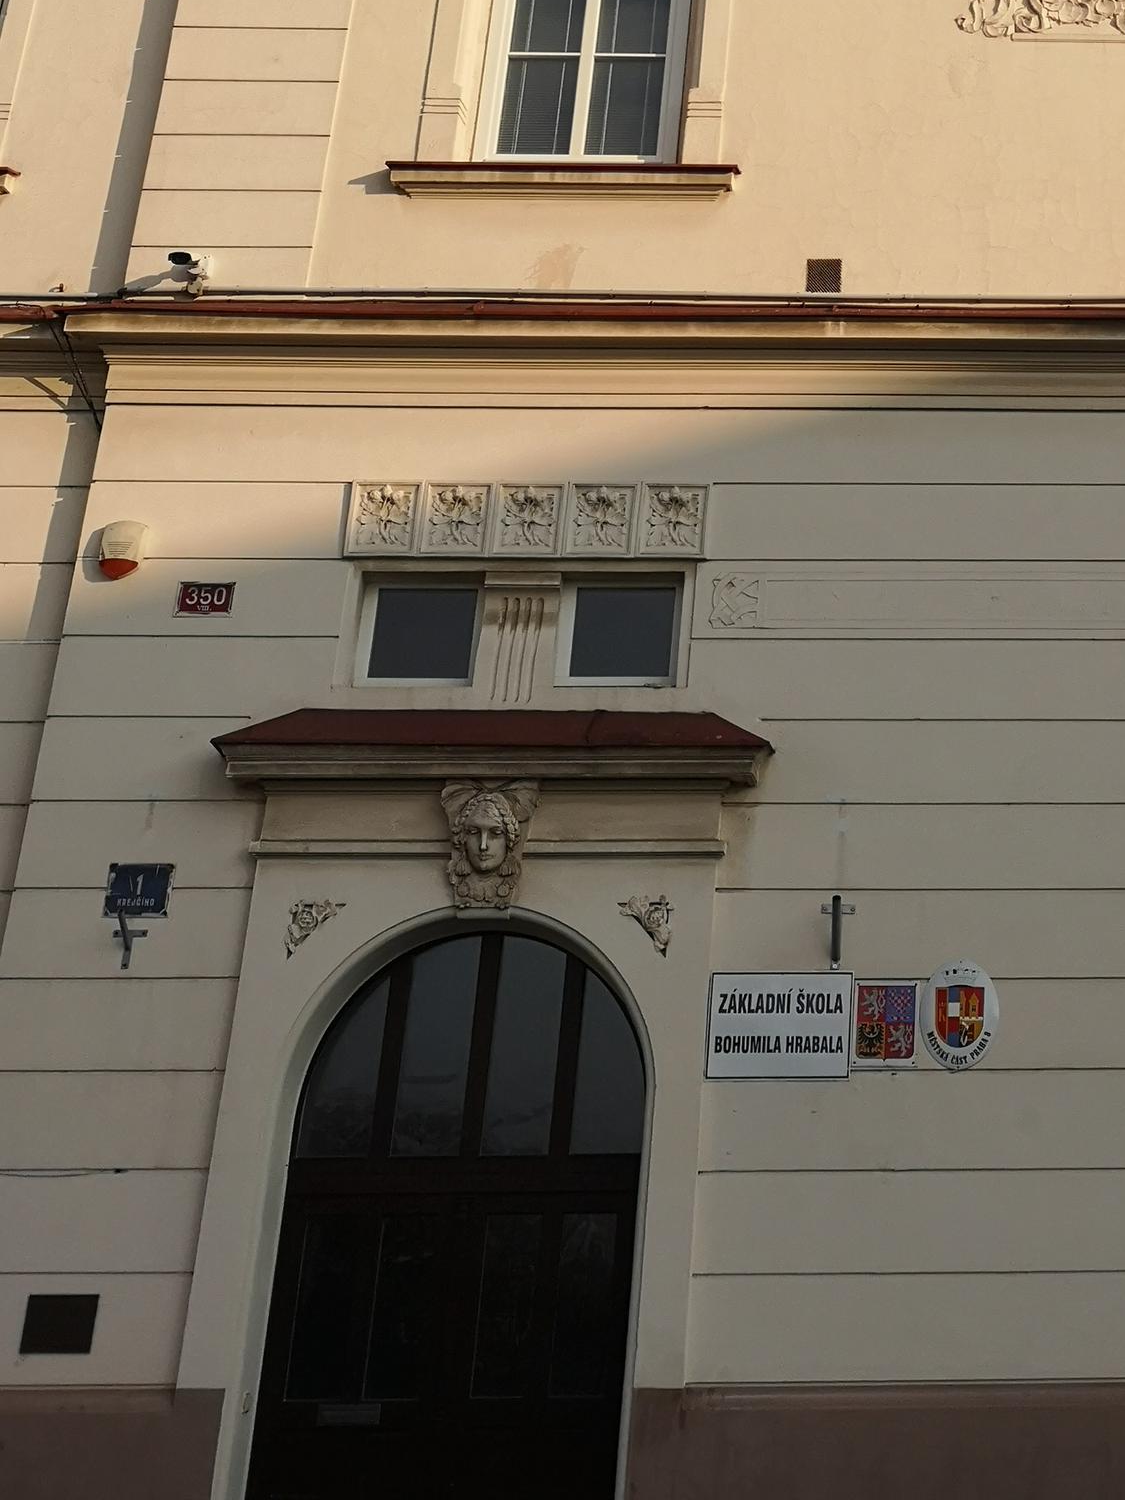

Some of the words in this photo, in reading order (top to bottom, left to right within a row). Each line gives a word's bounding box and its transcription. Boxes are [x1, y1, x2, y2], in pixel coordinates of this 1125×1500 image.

[185, 587, 227, 605] 350
[136, 874, 144, 895] 1
[718, 988, 794, 1014] ZÁKLADNÍ
[796, 988, 843, 1014] ŠKOLA
[715, 1035, 781, 1054] BOHUMILA
[785, 1035, 843, 1054] HRABALA
[951, 1054, 969, 1065] ČÁST
